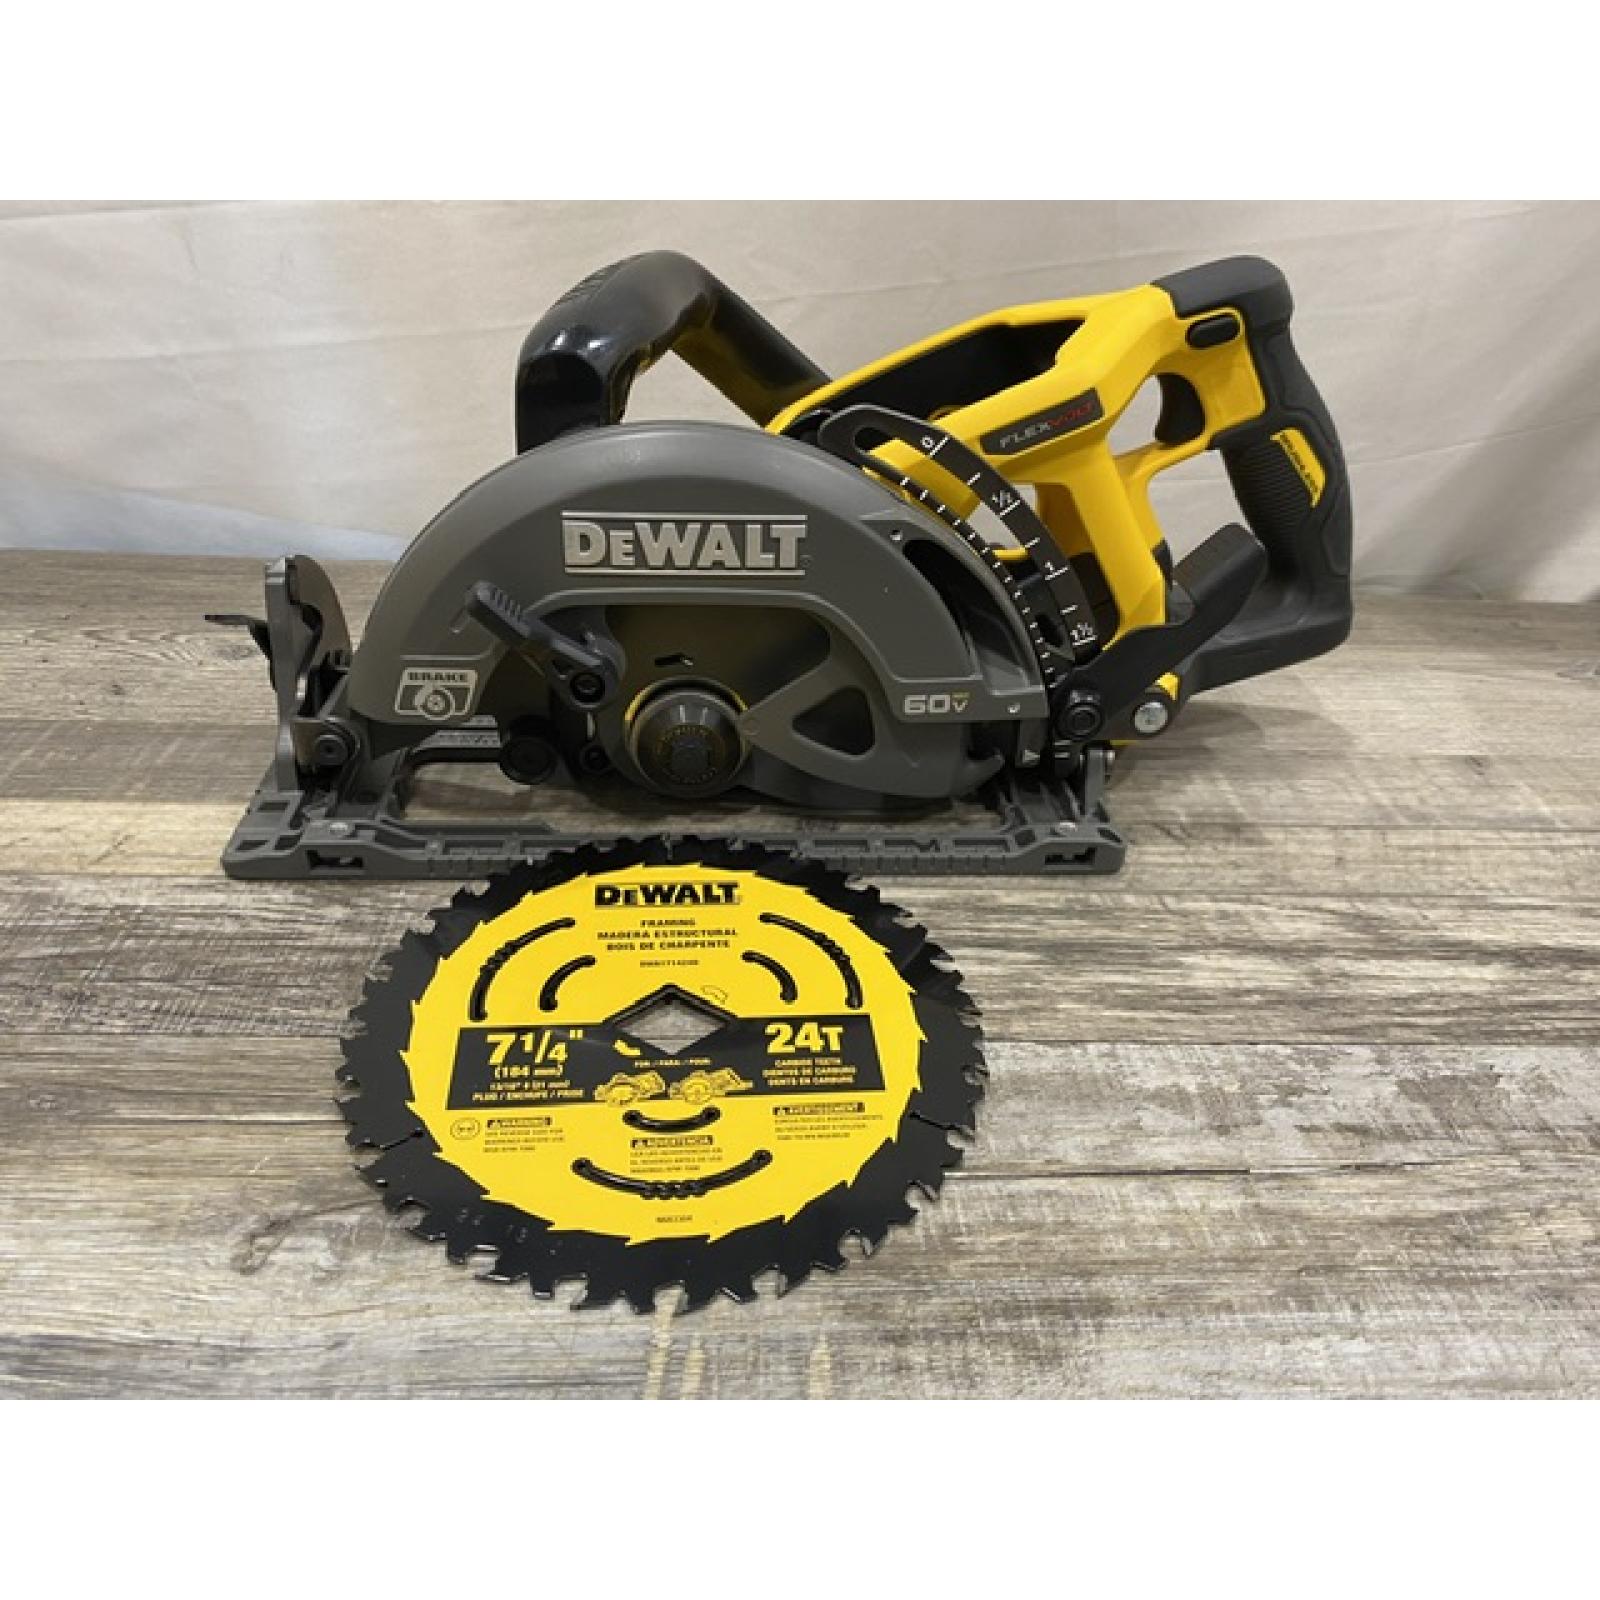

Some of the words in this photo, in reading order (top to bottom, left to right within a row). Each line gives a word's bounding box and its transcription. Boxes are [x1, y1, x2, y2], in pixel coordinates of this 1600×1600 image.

[407, 671, 467, 682] BRAKE
[640, 918, 696, 928] FRAMING
[597, 931, 650, 940] MADERA
[654, 929, 737, 938] ESTRUCTURAL
[606, 942, 636, 951] BOIS
[640, 941, 656, 950] DE
[659, 939, 730, 949] CHARPENTE
[764, 1021, 844, 1054] 24T
[814, 1057, 842, 1066] TEETH
